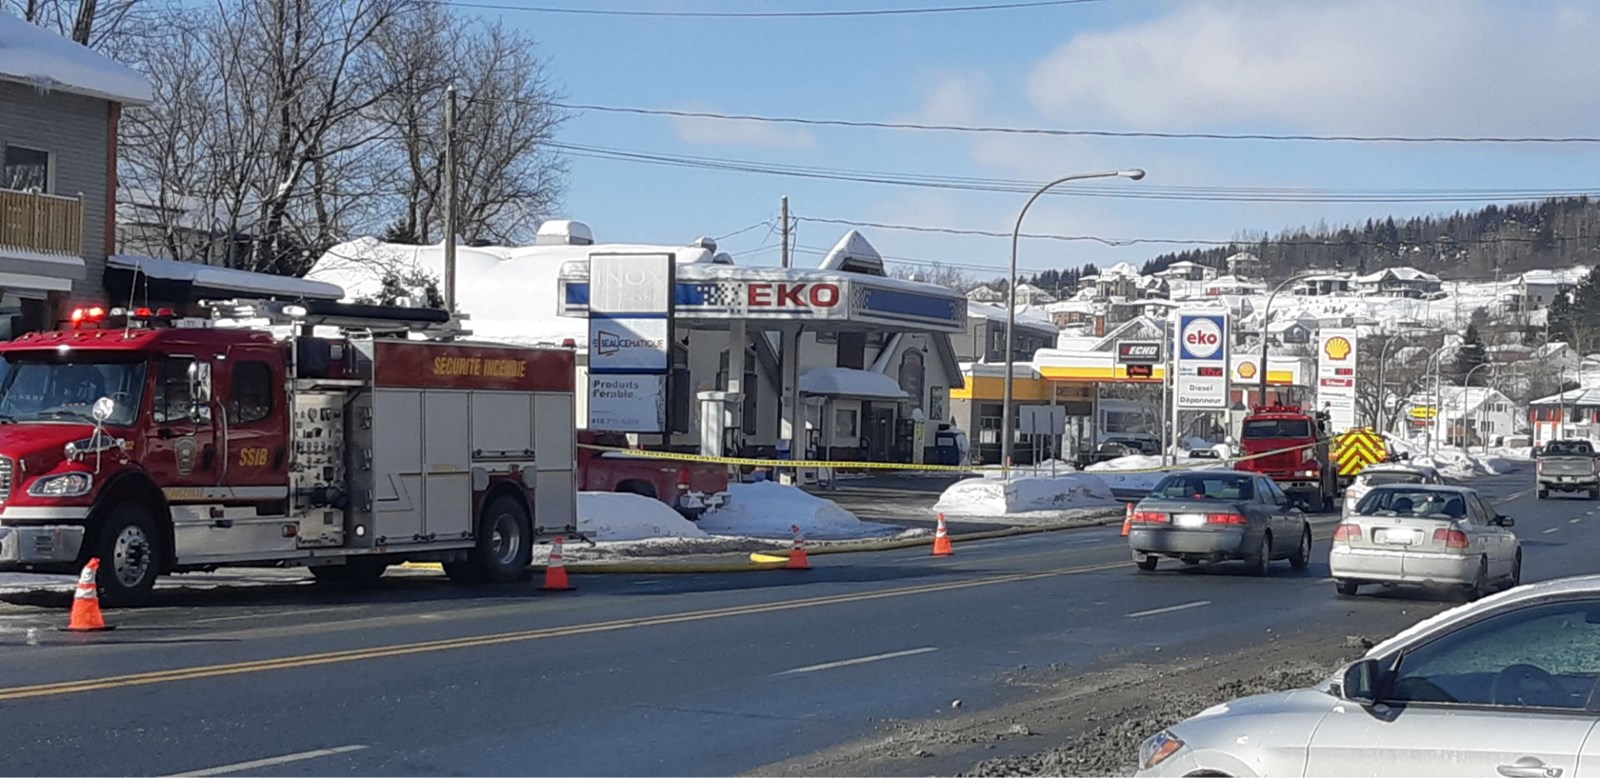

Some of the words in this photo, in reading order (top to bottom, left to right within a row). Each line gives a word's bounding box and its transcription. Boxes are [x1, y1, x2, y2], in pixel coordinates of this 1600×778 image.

[747, 283, 840, 308] EKO
[1187, 329, 1218, 345] eko
[1128, 345, 1158, 355] ECHO
[483, 359, 527, 378] INCENDIE
[593, 380, 640, 390] Produits
[1189, 384, 1213, 392] Diesel
[239, 448, 268, 466] SSIB
